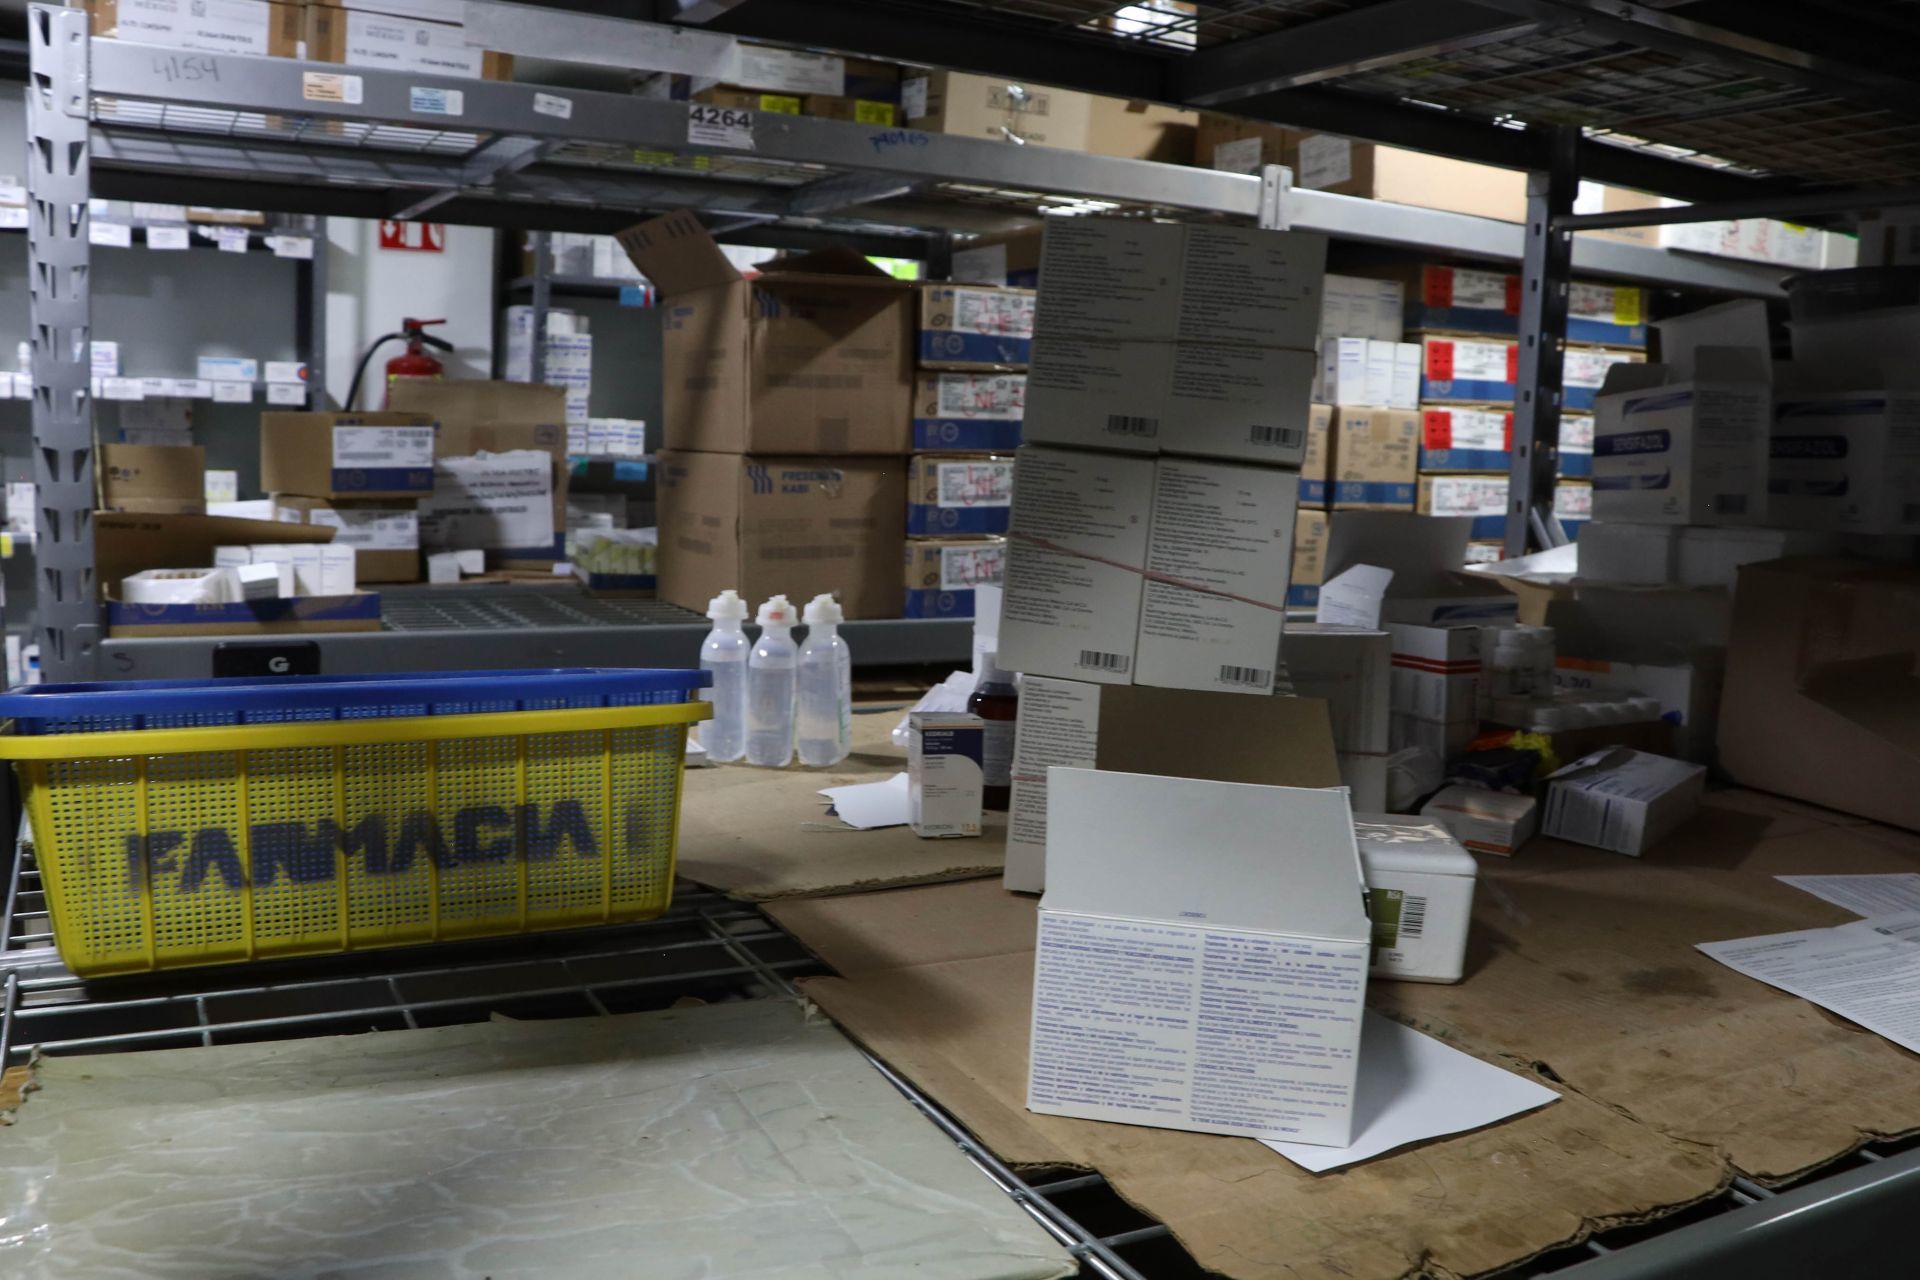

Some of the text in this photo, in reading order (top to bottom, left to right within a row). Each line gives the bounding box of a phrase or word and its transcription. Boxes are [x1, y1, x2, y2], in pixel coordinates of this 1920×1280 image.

[152, 55, 220, 82] 4154
[690, 106, 750, 128] 4264
[269, 656, 290, 673] G
[127, 799, 599, 894] FARMACIA
